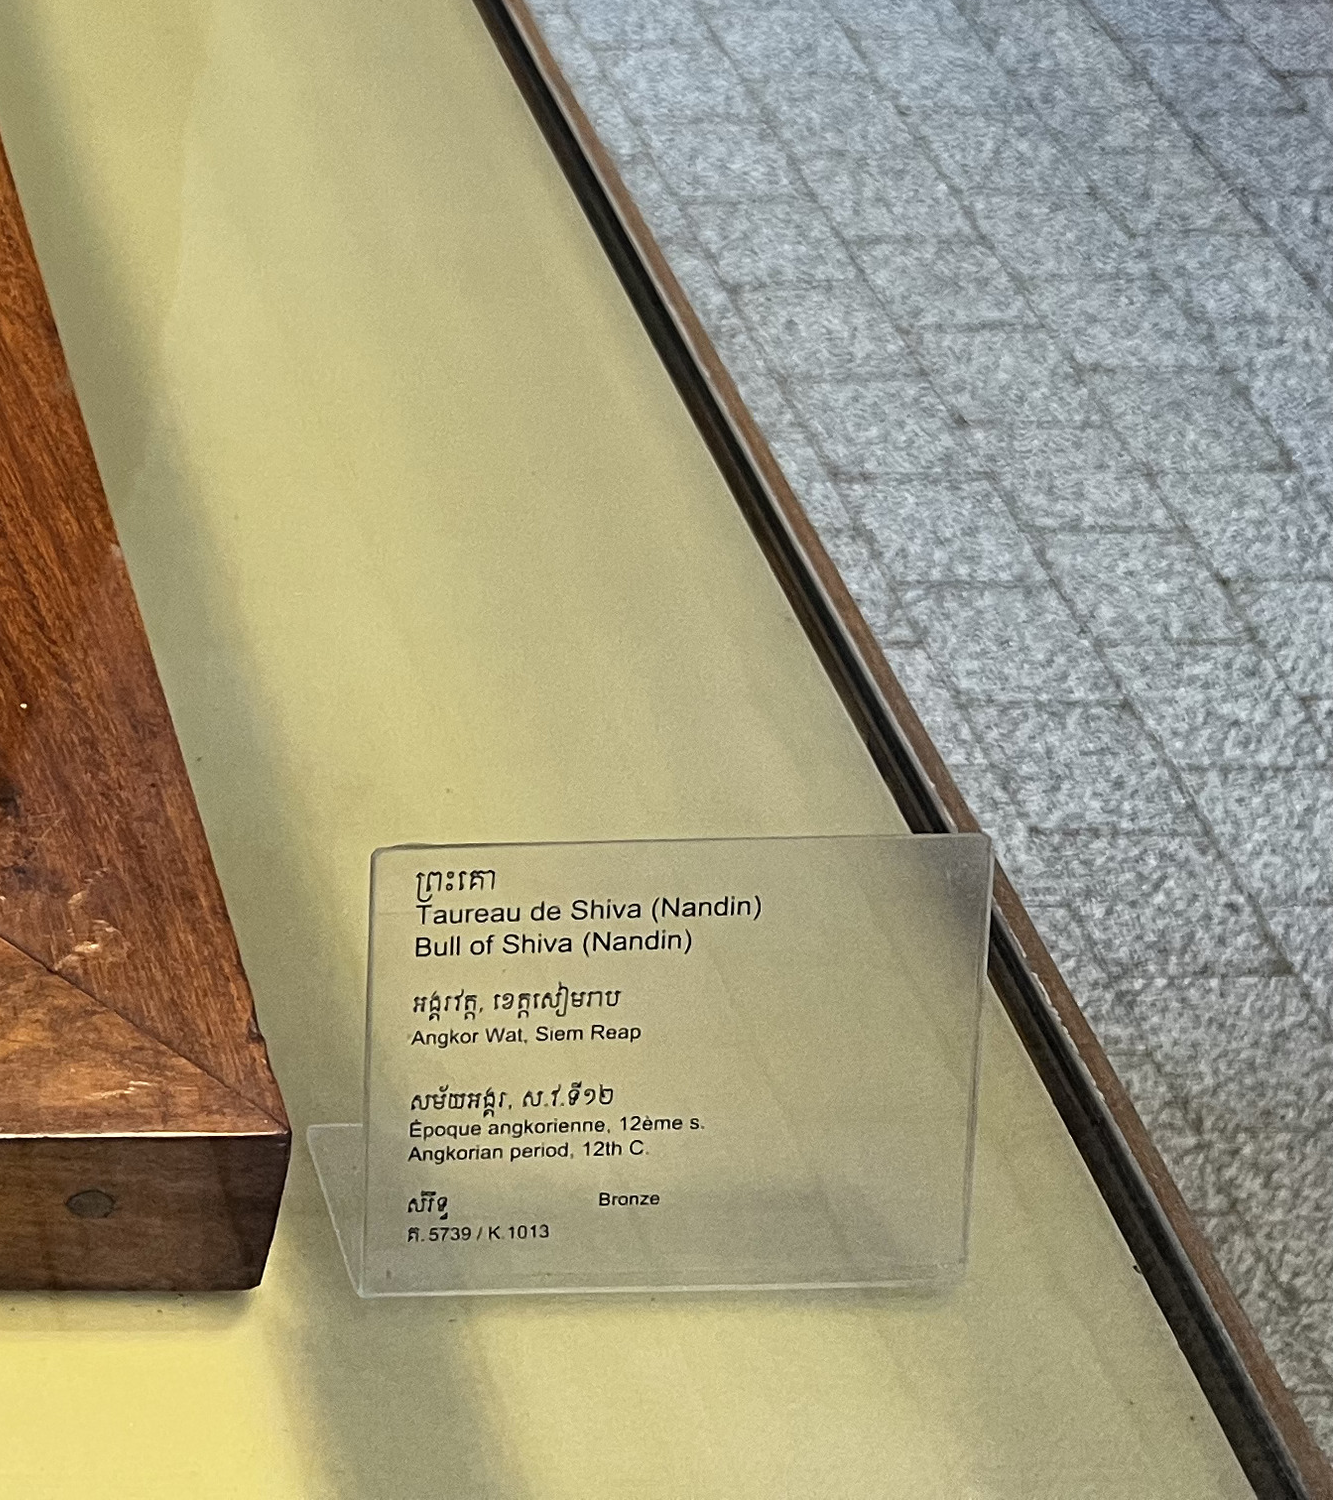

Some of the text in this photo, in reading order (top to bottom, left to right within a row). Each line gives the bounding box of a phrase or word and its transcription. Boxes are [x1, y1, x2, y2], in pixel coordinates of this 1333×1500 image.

[415, 869, 496, 903] ព្រះគោ
[415, 895, 762, 925] Taureau de Shiva (Nandin)
[415, 929, 692, 958] Bull of Shiva (Nandin)
[411, 1024, 642, 1049] Angkor Wat, Siem Reap
[409, 1115, 705, 1141] Époque angkorienne, 12ème s.
[408, 1139, 650, 1165] Angkorian period, 12th C.
[598, 1192, 661, 1207] Bronze
[476, 1226, 483, 1241] /
